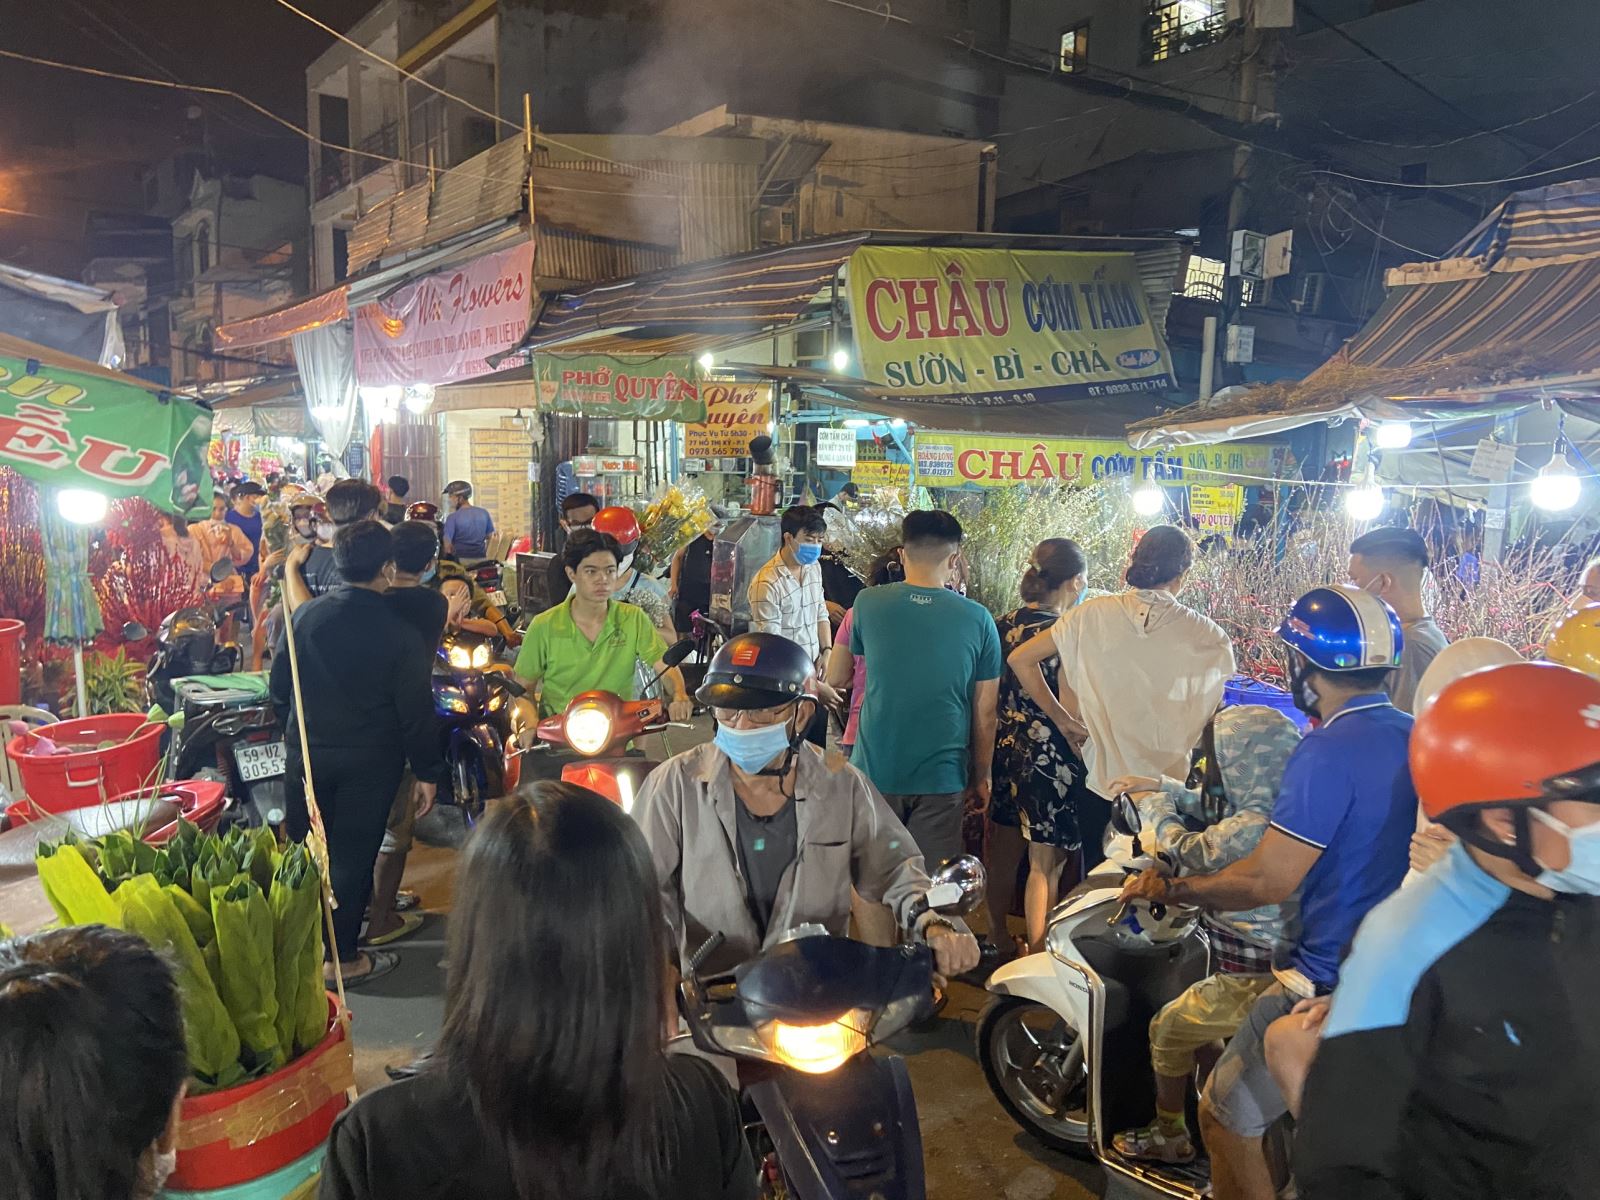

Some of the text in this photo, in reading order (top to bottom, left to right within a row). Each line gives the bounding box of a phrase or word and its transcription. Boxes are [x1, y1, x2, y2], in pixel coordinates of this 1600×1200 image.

[448, 272, 526, 325] Flowers
[865, 260, 1145, 342] CHÂU CƠM TẤM
[885, 352, 968, 388] SƯỜN
[992, 348, 1025, 382] BÌ
[1051, 342, 1112, 376] CHẢ
[562, 366, 612, 387] PHỞ
[614, 371, 699, 404] QUYÊN
[703, 386, 758, 407] Phở
[697, 408, 765, 429] uyên
[957, 443, 1084, 481] CHÂU
[1091, 452, 1137, 480] CƠM
